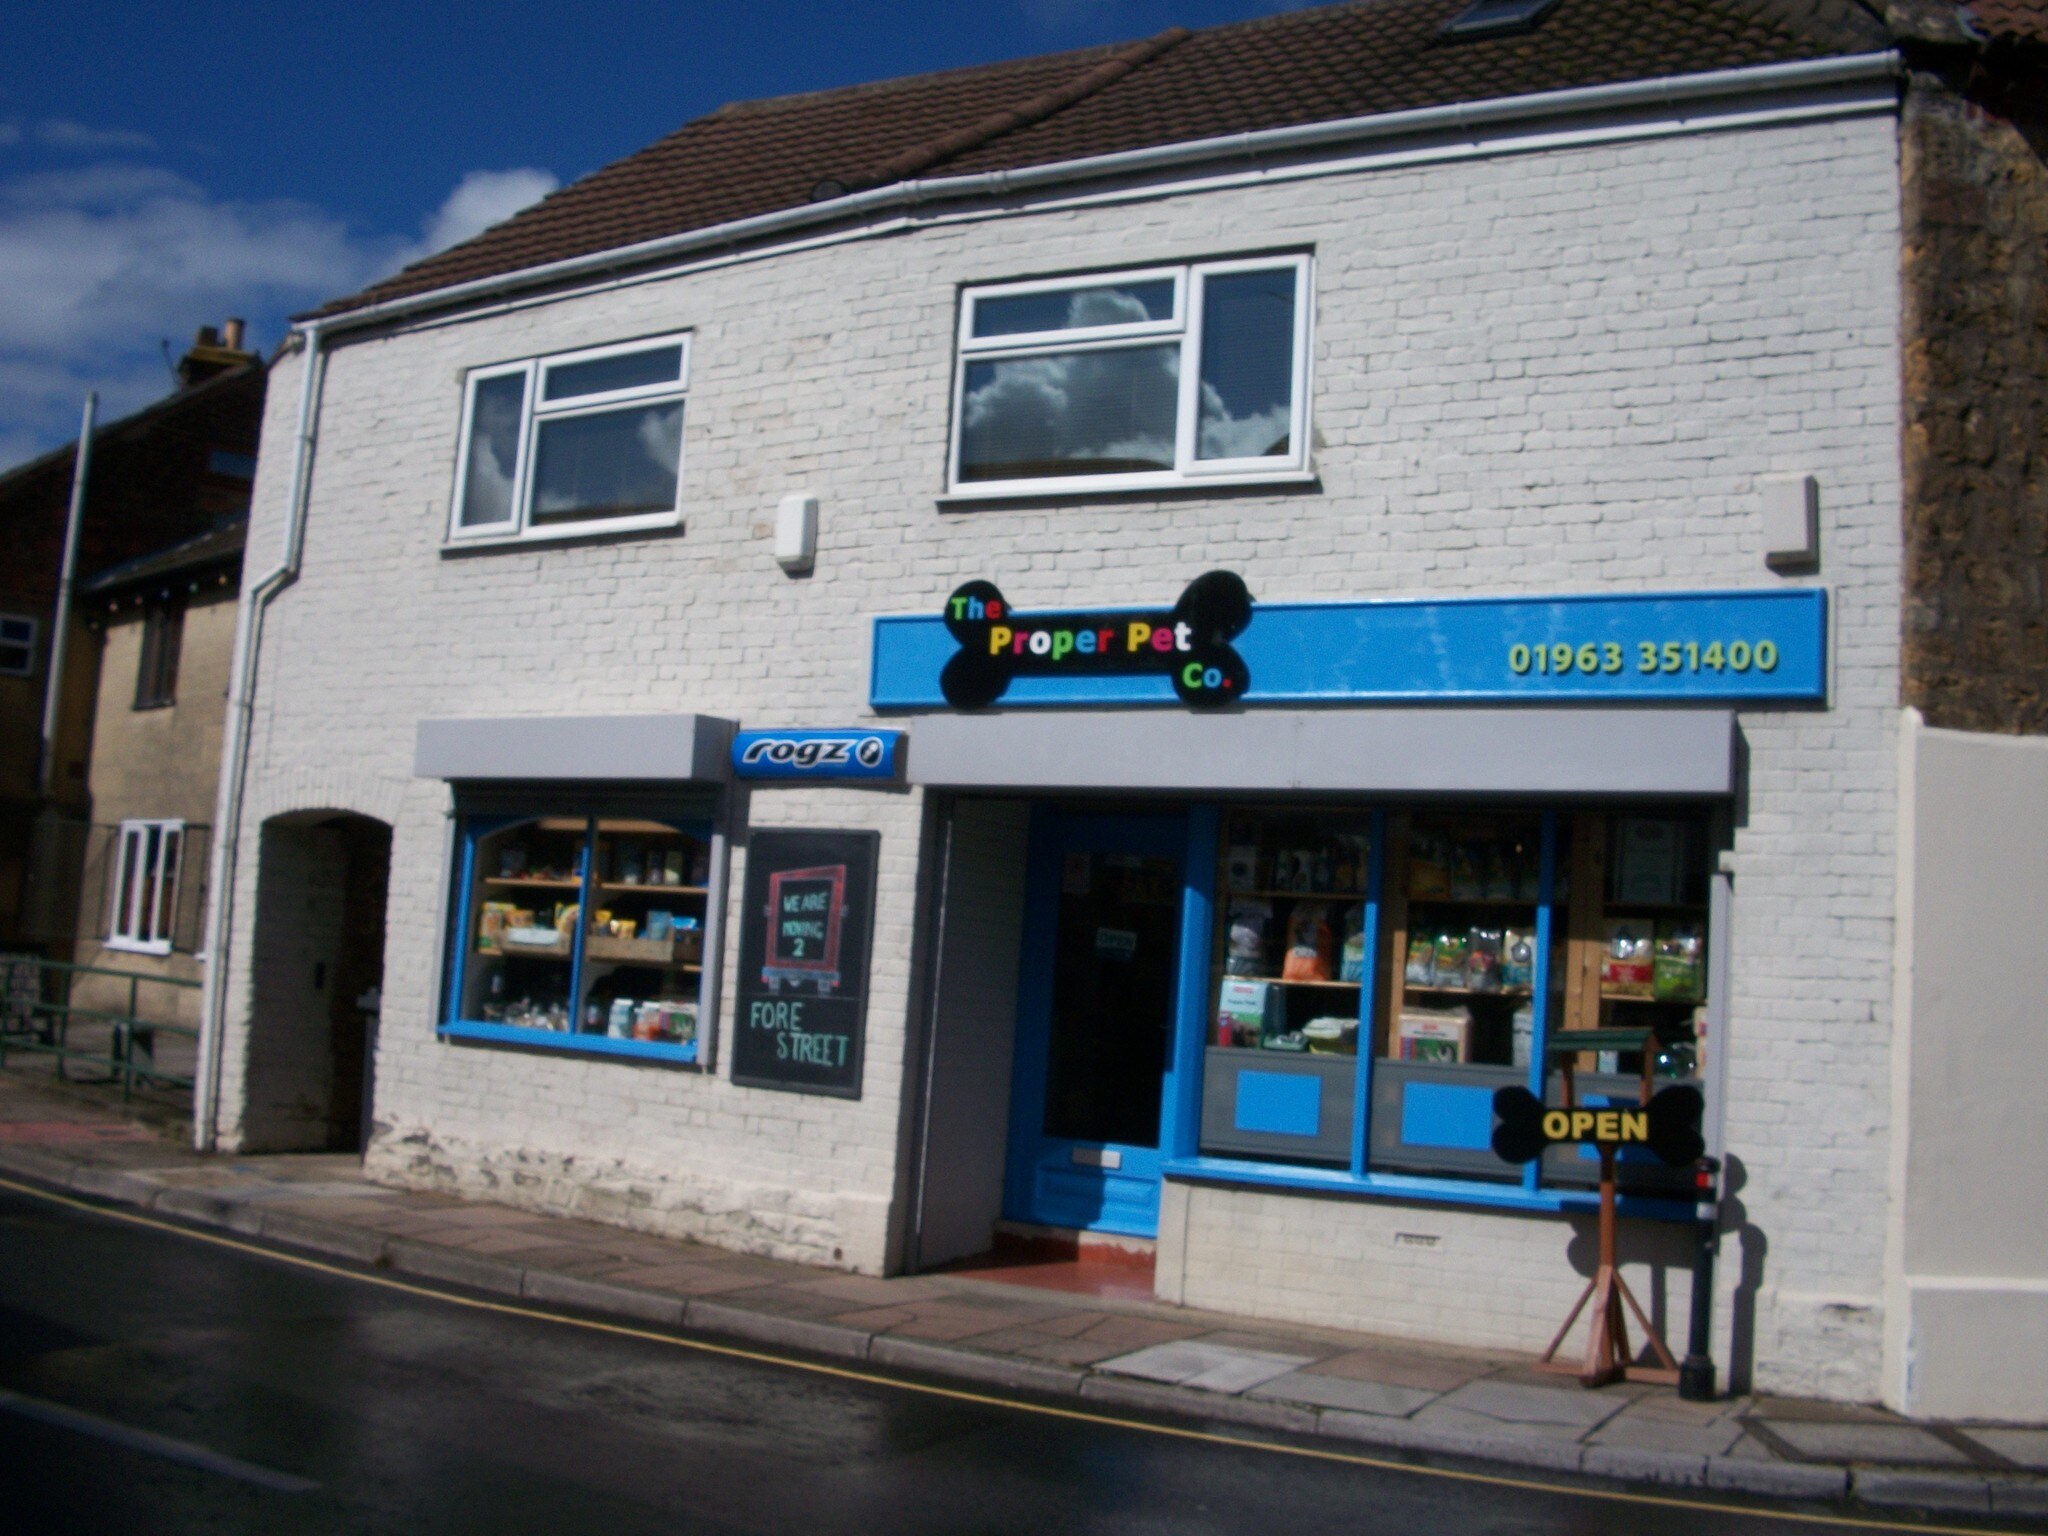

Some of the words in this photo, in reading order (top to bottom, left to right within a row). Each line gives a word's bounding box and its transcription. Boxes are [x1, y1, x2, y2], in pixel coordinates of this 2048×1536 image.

[950, 596, 1000, 620] The
[989, 626, 1115, 661] Proper
[1127, 622, 1192, 652] Pet
[1508, 642, 1623, 674] 01963
[1637, 639, 1778, 673] 351400
[1181, 662, 1232, 689] Co.
[742, 737, 859, 770] rogz
[783, 895, 801, 913] WE
[801, 892, 828, 911] ARE
[791, 937, 807, 958] 2
[750, 1000, 804, 1032] FORE
[776, 1032, 849, 1067] STREET
[1542, 1110, 1649, 1142] OPEN
